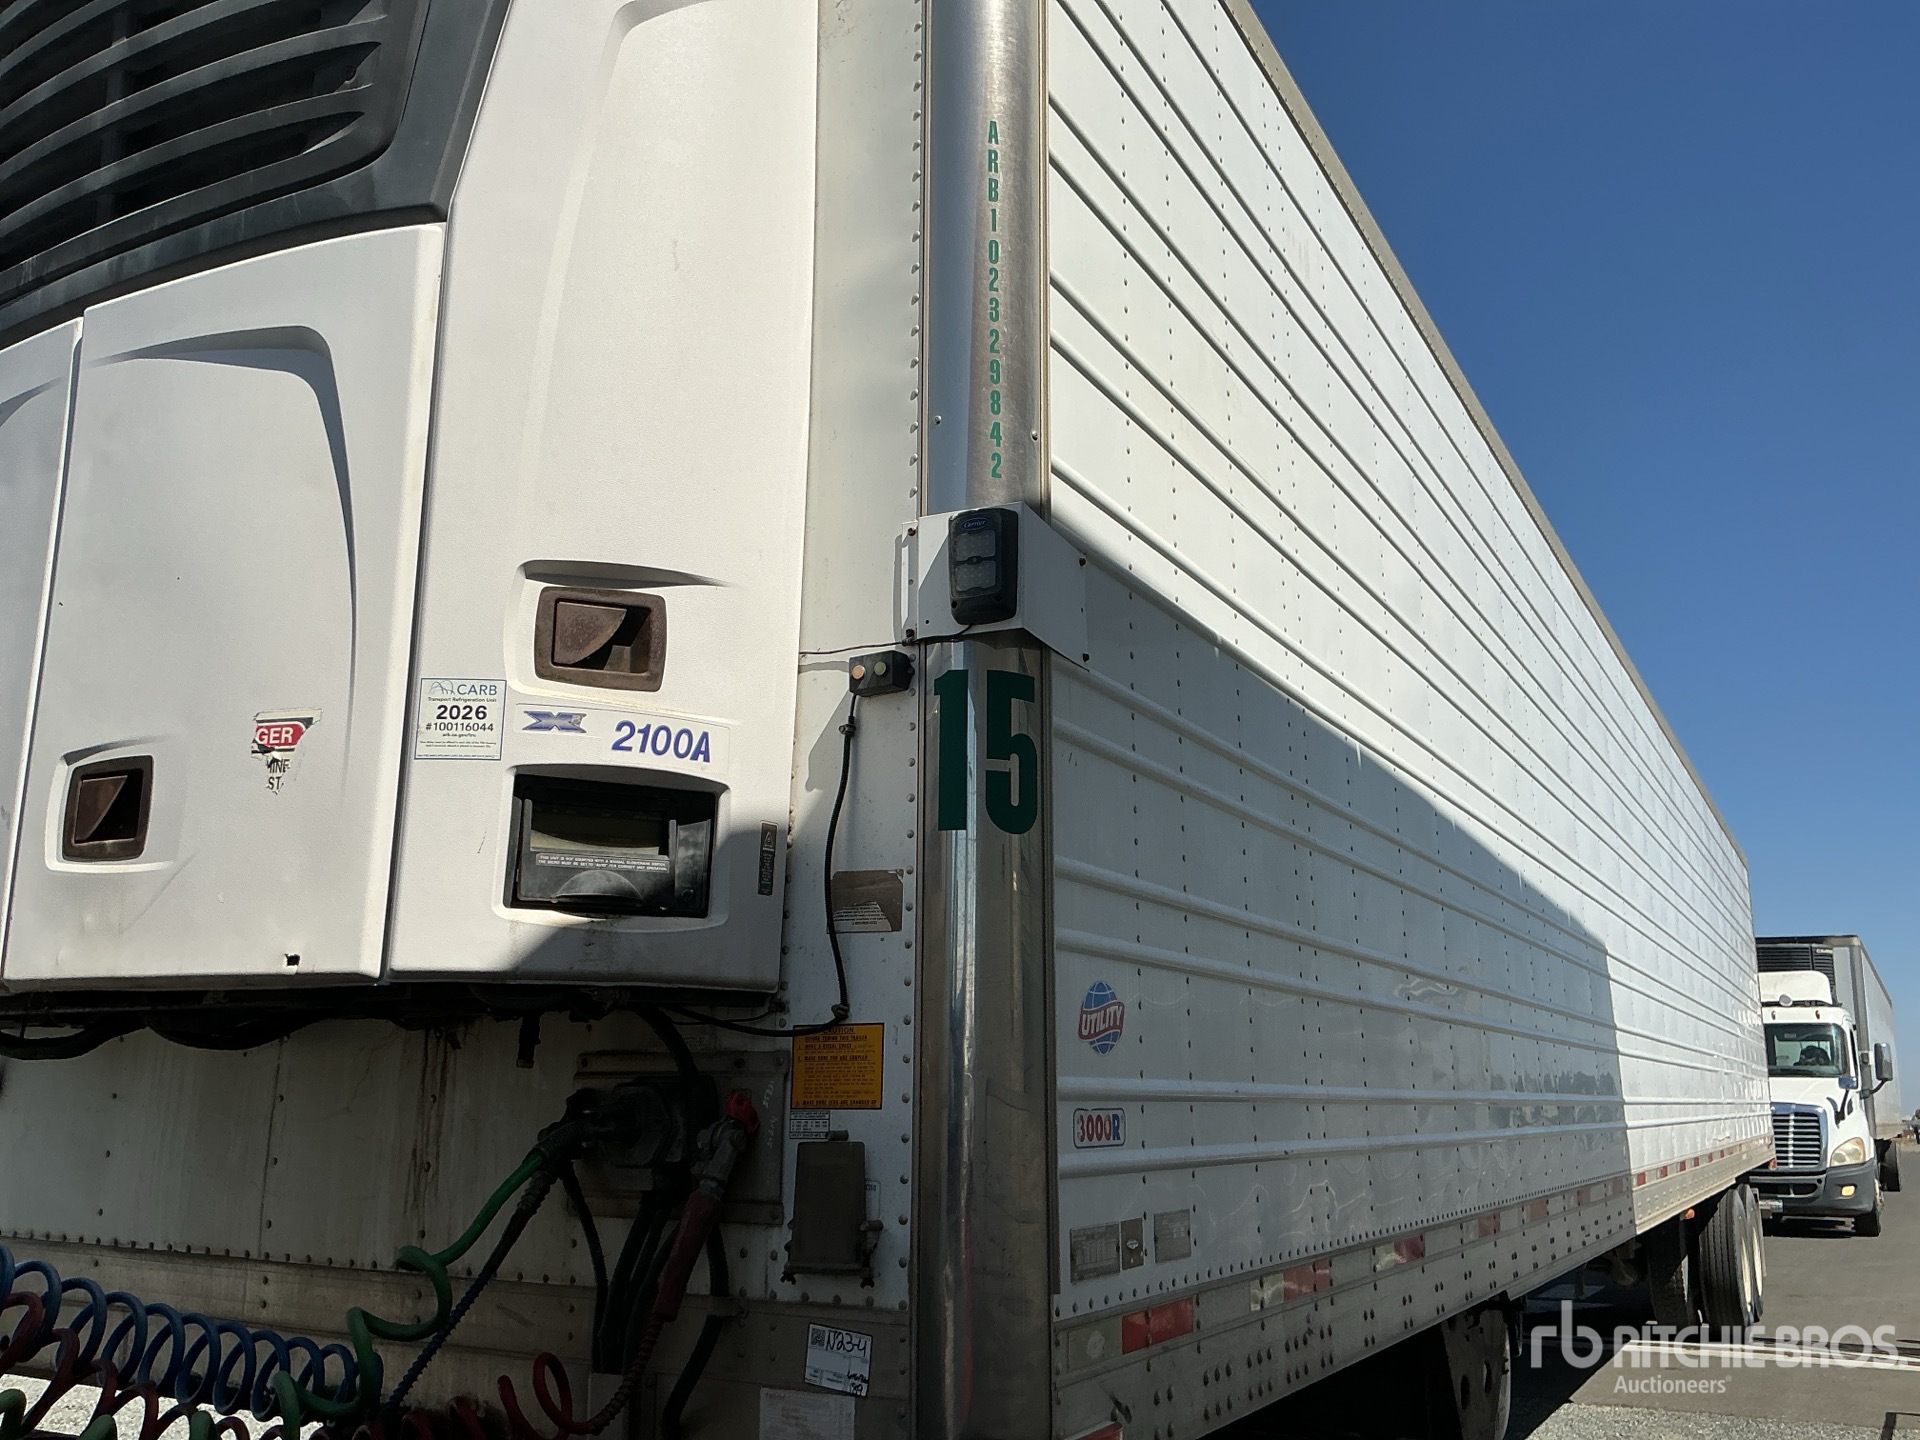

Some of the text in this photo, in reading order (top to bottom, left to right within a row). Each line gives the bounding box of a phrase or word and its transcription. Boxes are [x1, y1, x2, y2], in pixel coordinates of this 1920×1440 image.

[987, 120, 1003, 479] ARB102329842
[457, 684, 498, 696] CARB
[436, 704, 488, 720] 2026
[254, 726, 294, 745] GER
[425, 722, 494, 732] #100116044
[611, 719, 711, 763] 2100A
[933, 669, 1038, 835] 15
[1081, 1005, 1123, 1036] UTILITY
[1077, 1114, 1121, 1142] 3000R
